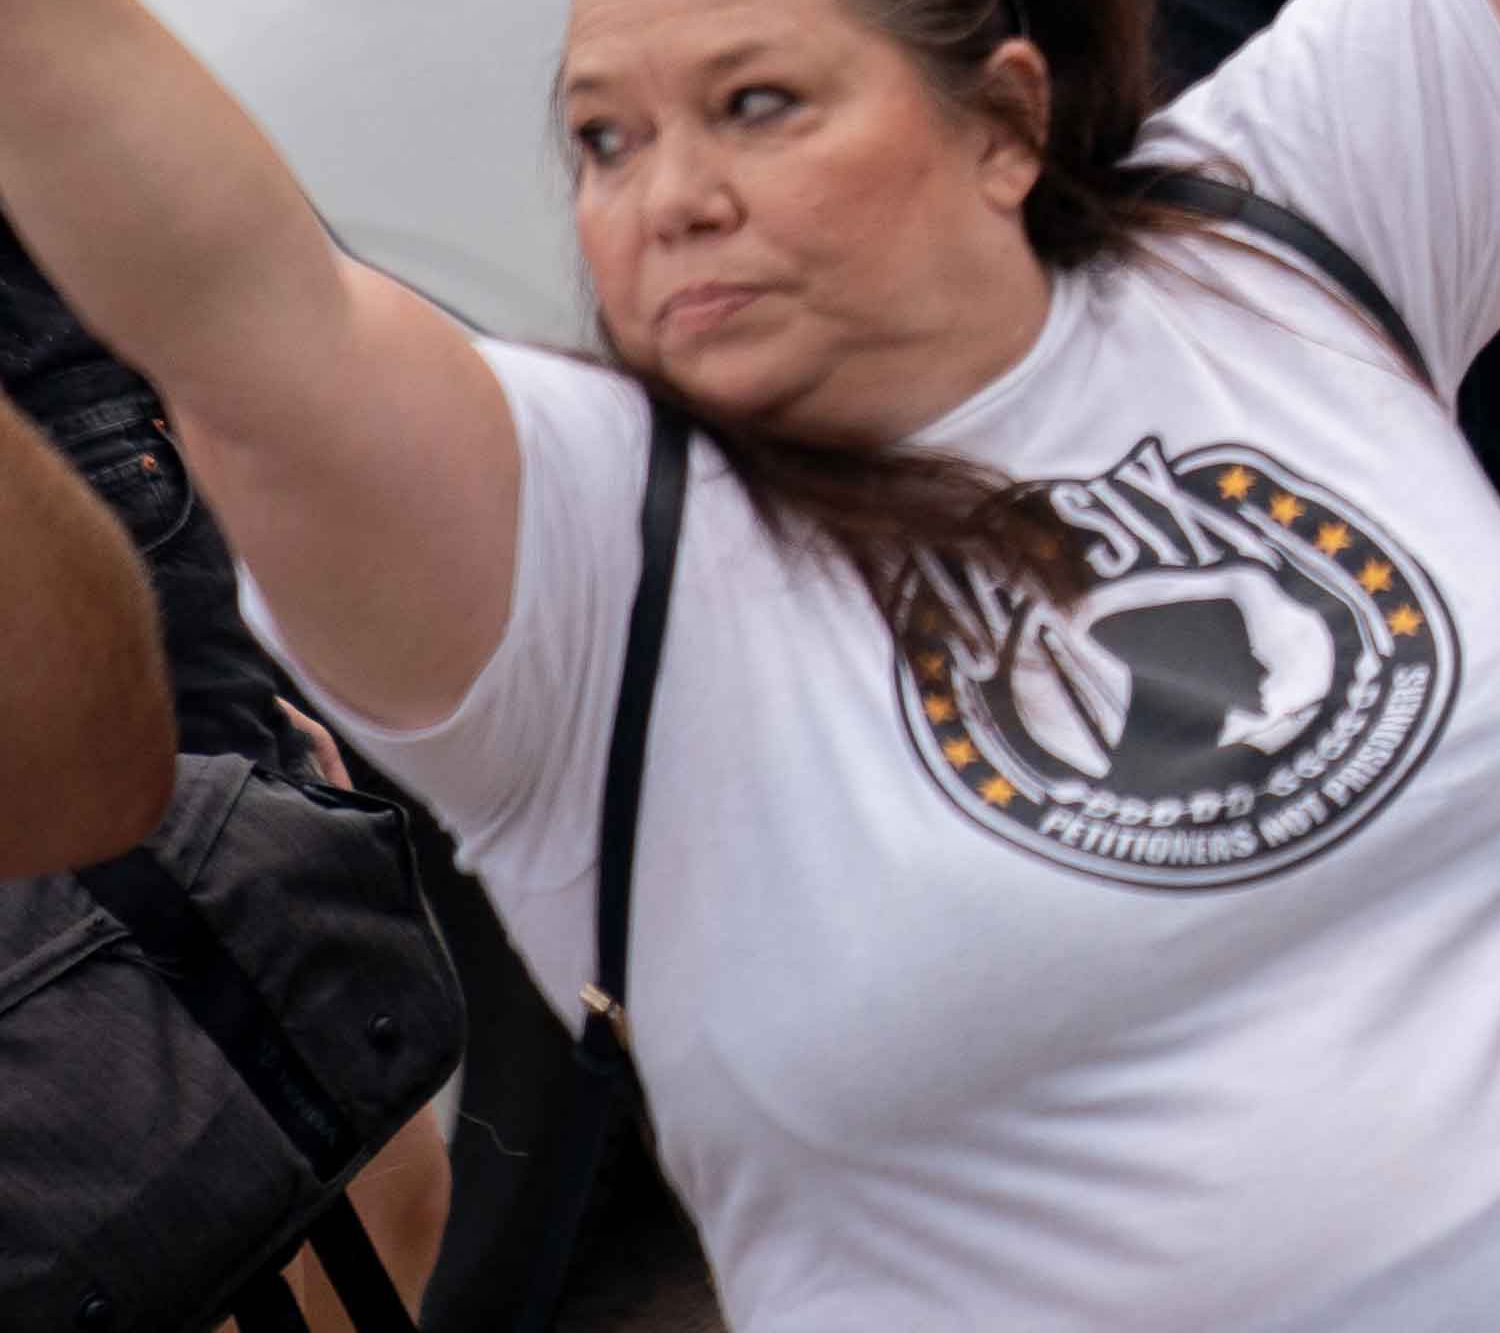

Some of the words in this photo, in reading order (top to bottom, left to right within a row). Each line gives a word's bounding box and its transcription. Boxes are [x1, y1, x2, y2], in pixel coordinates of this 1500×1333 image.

[1049, 433, 1285, 579] SIX
[1039, 805, 1259, 866] PETITIONERS
[1258, 790, 1328, 849] NOT
[1320, 663, 1432, 809] PRISONERS
